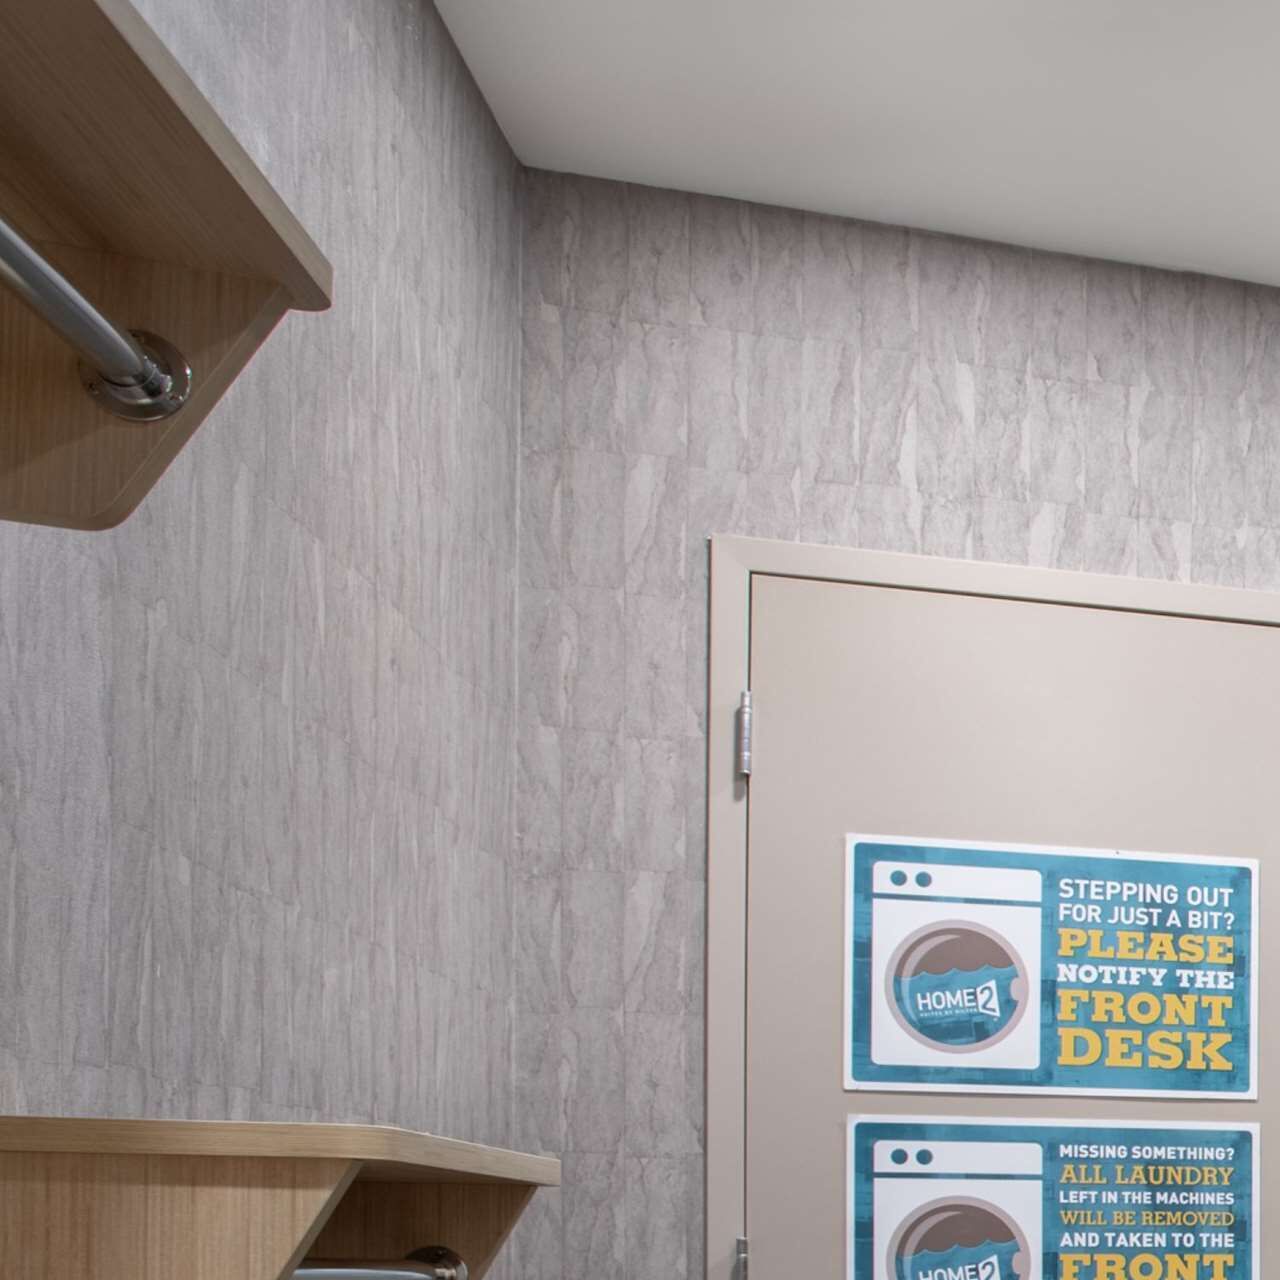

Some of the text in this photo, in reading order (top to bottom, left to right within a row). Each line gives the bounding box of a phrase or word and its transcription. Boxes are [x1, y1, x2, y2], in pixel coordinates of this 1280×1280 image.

[1059, 878, 1234, 908] STEPPING OUT
[1059, 903, 1235, 930] FOR JUST A BIT?
[1057, 928, 1234, 965] PLEASE
[1057, 963, 1234, 990] NOTIFY THE
[1057, 988, 1233, 1027] FRONT
[1057, 1027, 1233, 1071] DESK
[1059, 1144, 1235, 1161] MISSING SOMETHING?
[1059, 1164, 1234, 1186] ALL LAUNDRY
[1059, 1190, 1234, 1205] LEFT IN THE MACHINES
[1059, 1210, 1235, 1227] WILL BE REMOVED
[1060, 1232, 1235, 1248] AND TAKEN TO THE
